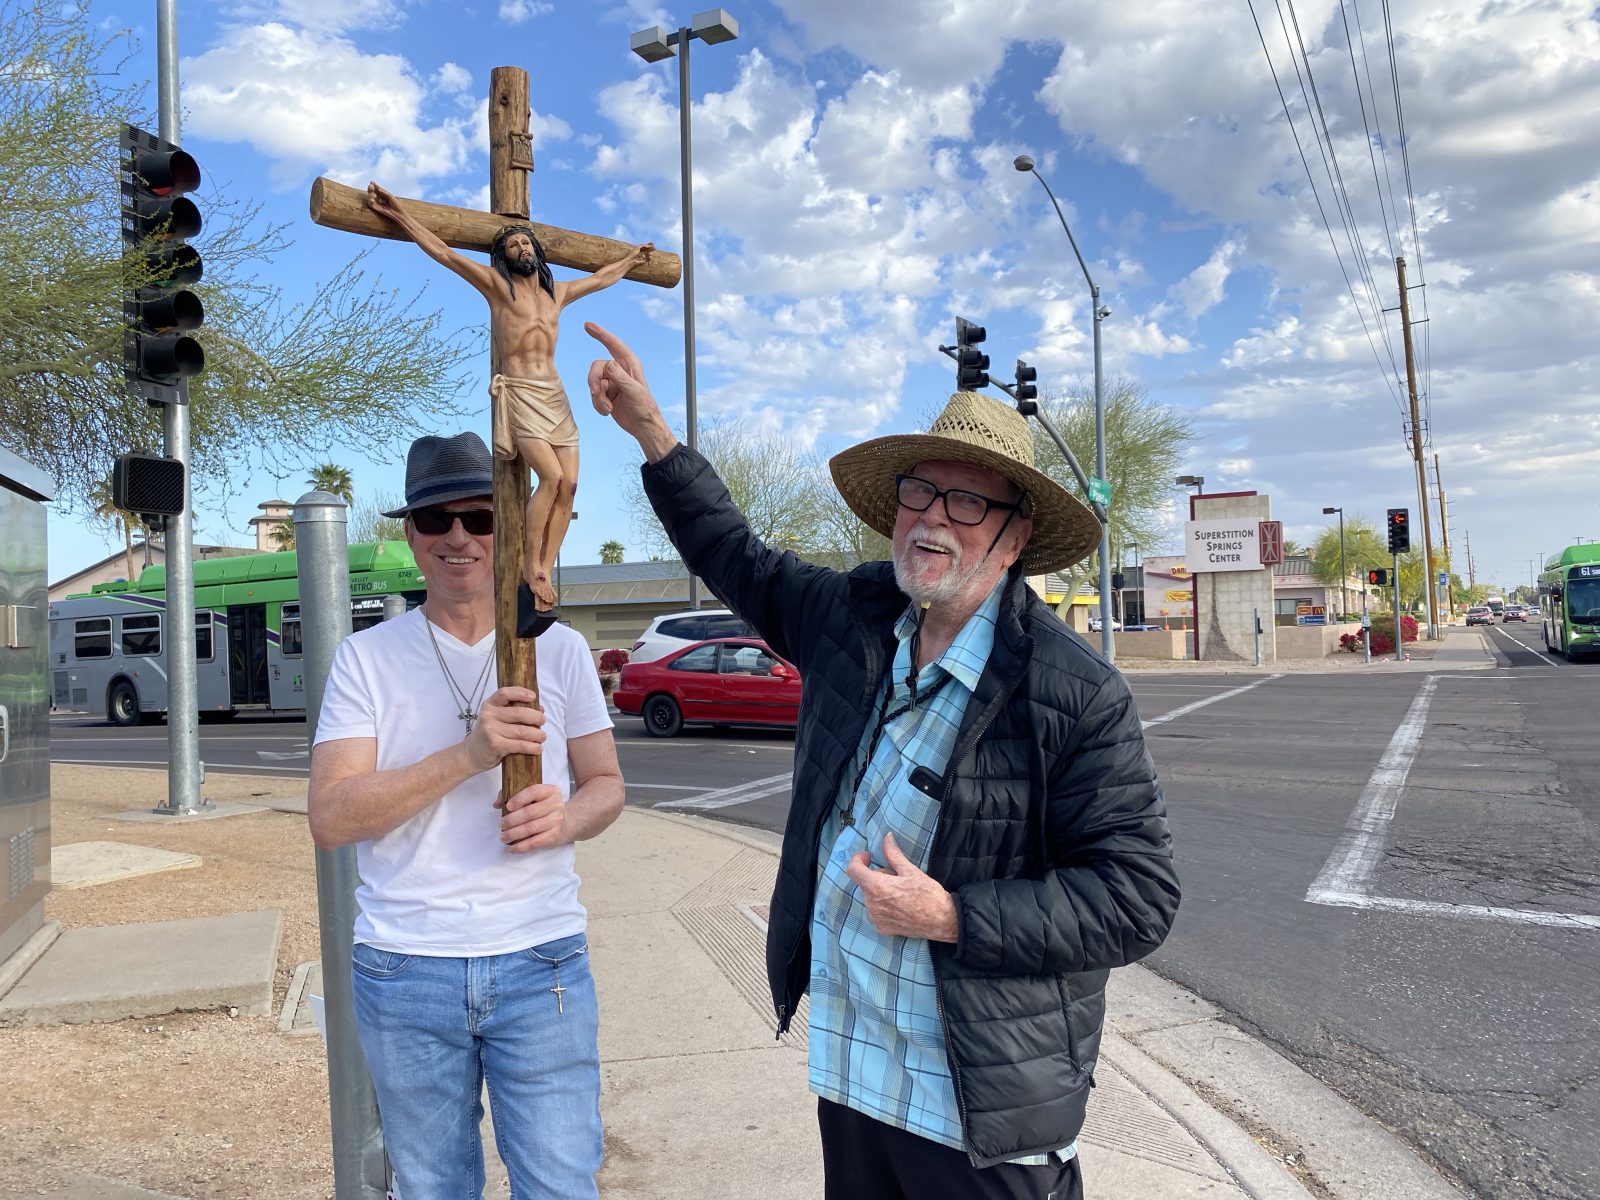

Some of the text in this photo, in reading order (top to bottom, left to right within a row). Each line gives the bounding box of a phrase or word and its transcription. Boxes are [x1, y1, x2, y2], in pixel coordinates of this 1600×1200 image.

[1195, 529, 1254, 540] SUPERSTITION
[1207, 541, 1242, 551] SPRINGS
[1209, 553, 1241, 563] CENTER
[1171, 567, 1187, 575] Den
[1581, 566, 1591, 575] 61
[374, 581, 387, 590] BUS
